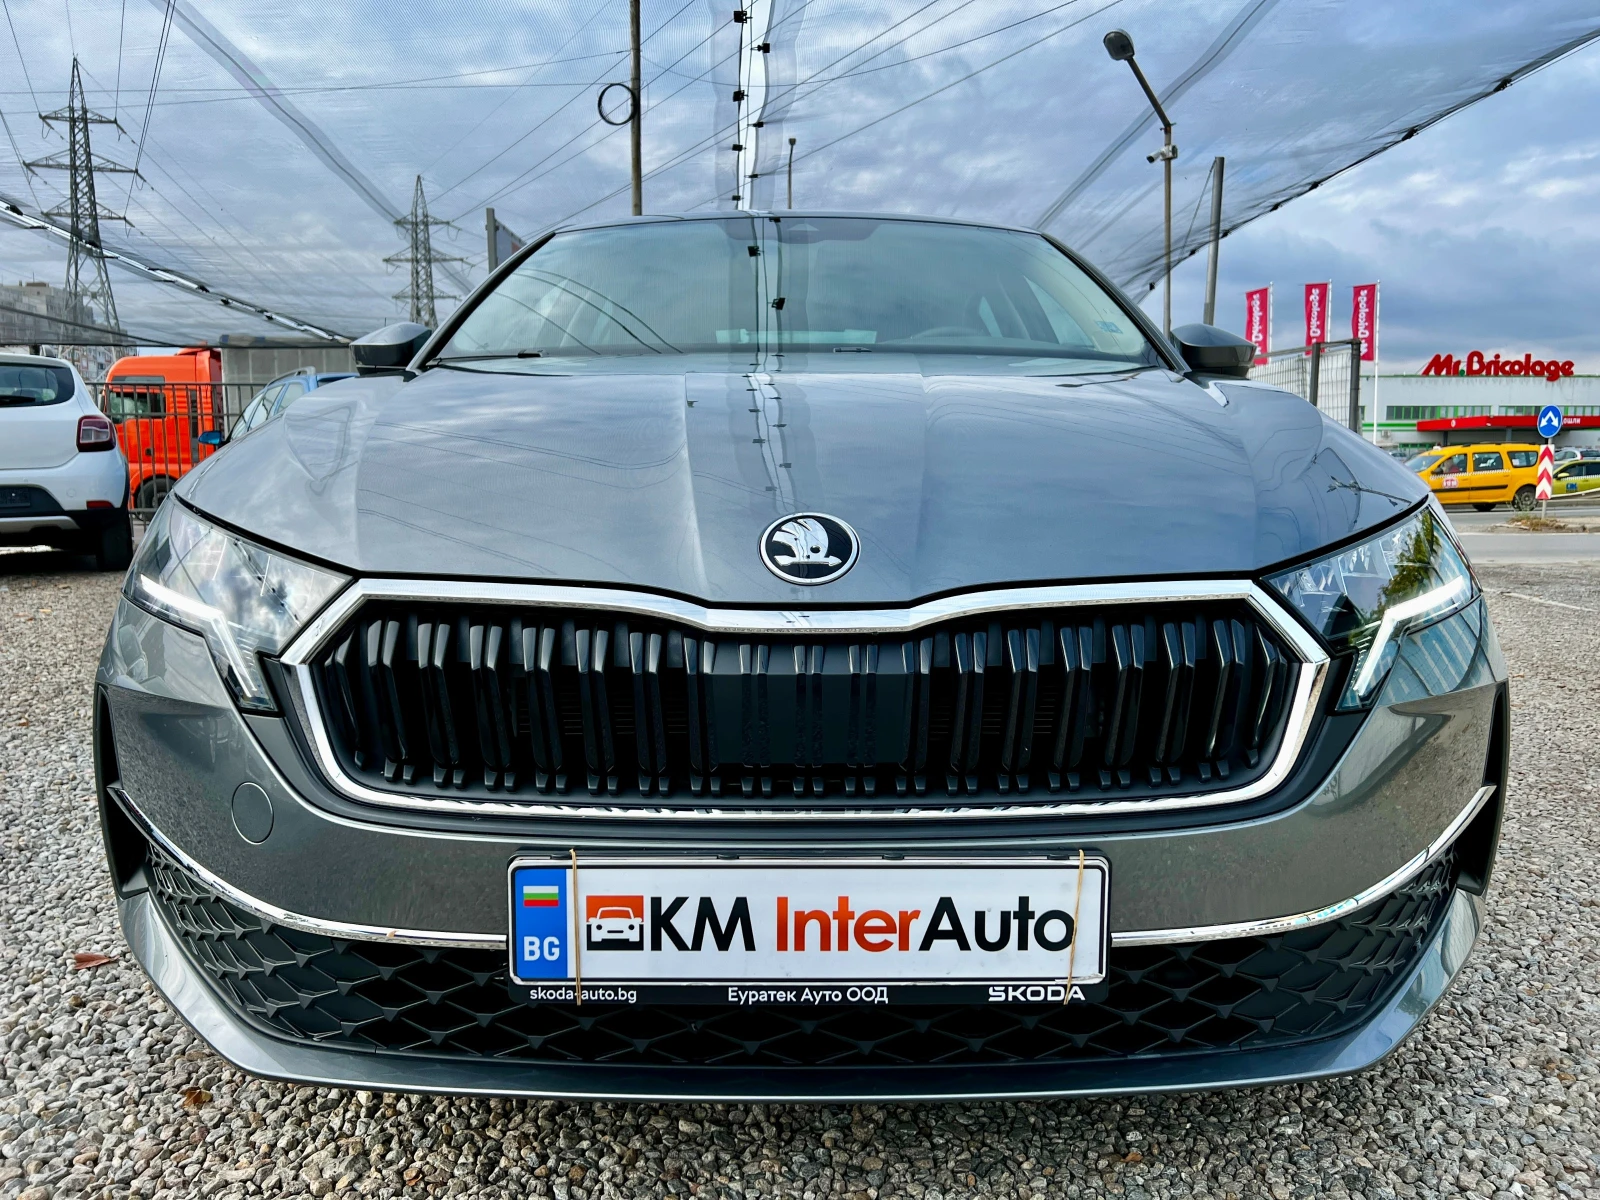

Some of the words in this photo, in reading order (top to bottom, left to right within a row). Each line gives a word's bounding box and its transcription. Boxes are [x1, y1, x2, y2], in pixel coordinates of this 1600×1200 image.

[650, 896, 756, 952] KM
[776, 896, 1075, 952] InterAuto
[523, 936, 560, 961] BG
[529, 987, 637, 1003] skoda-auto.bg
[727, 987, 797, 1004] Еуратек
[801, 987, 842, 1005] Ауто
[846, 987, 888, 1003] ООД
